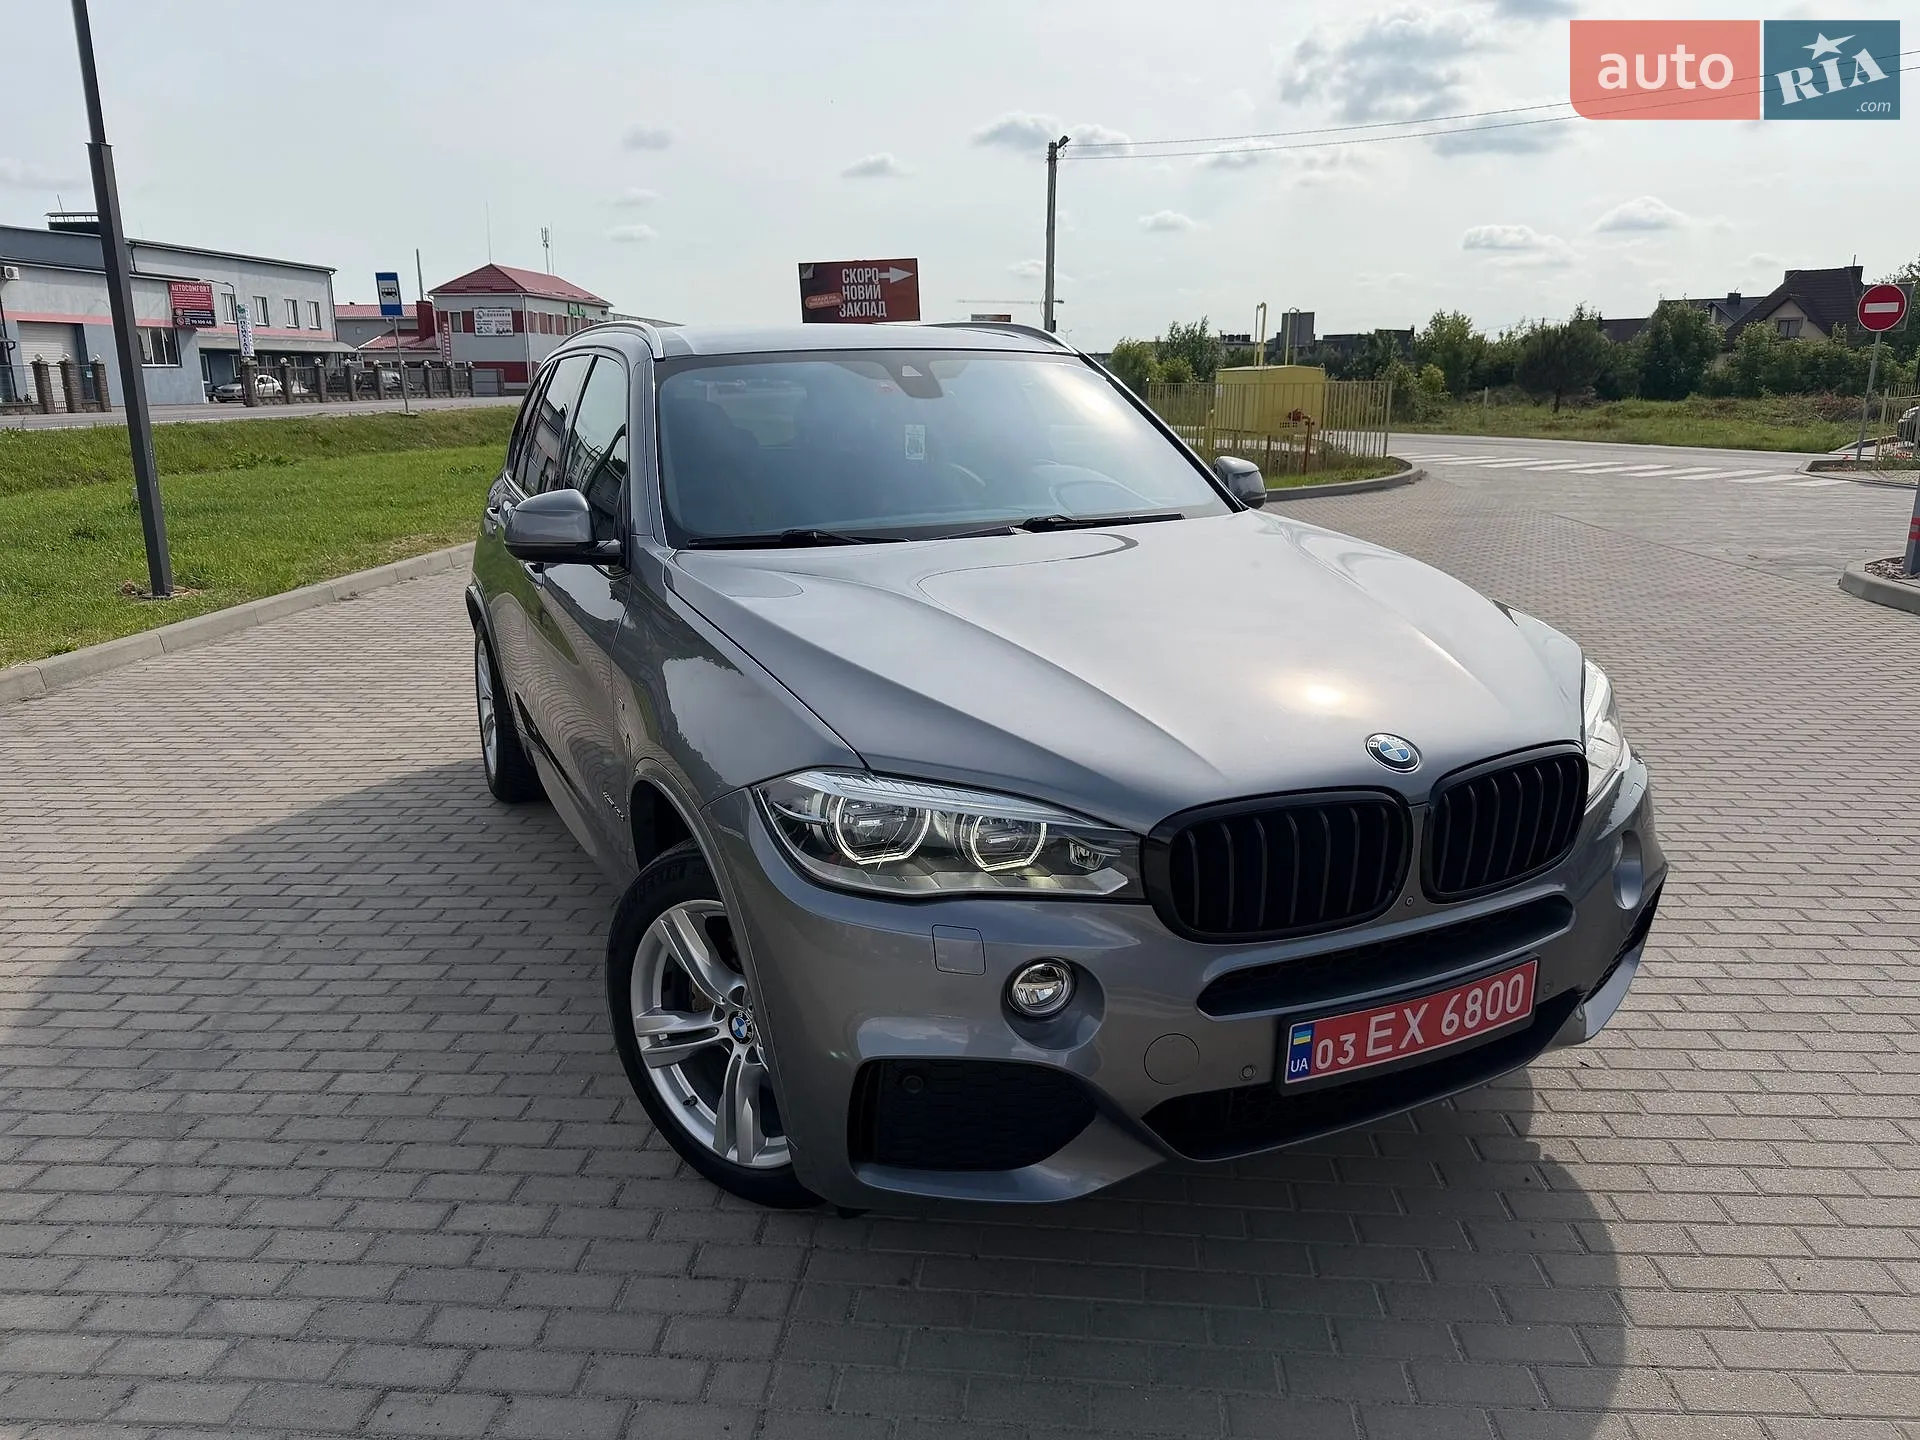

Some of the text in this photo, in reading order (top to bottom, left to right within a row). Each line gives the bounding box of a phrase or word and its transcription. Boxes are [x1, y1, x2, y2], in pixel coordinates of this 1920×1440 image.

[842, 267, 880, 284] СКОРО
[171, 284, 210, 293] AUTOCOMFORT
[839, 301, 887, 318] ЗАКЛАД
[1315, 973, 1525, 1070] 03 EX 6800
[1290, 1058, 1309, 1073] UA
